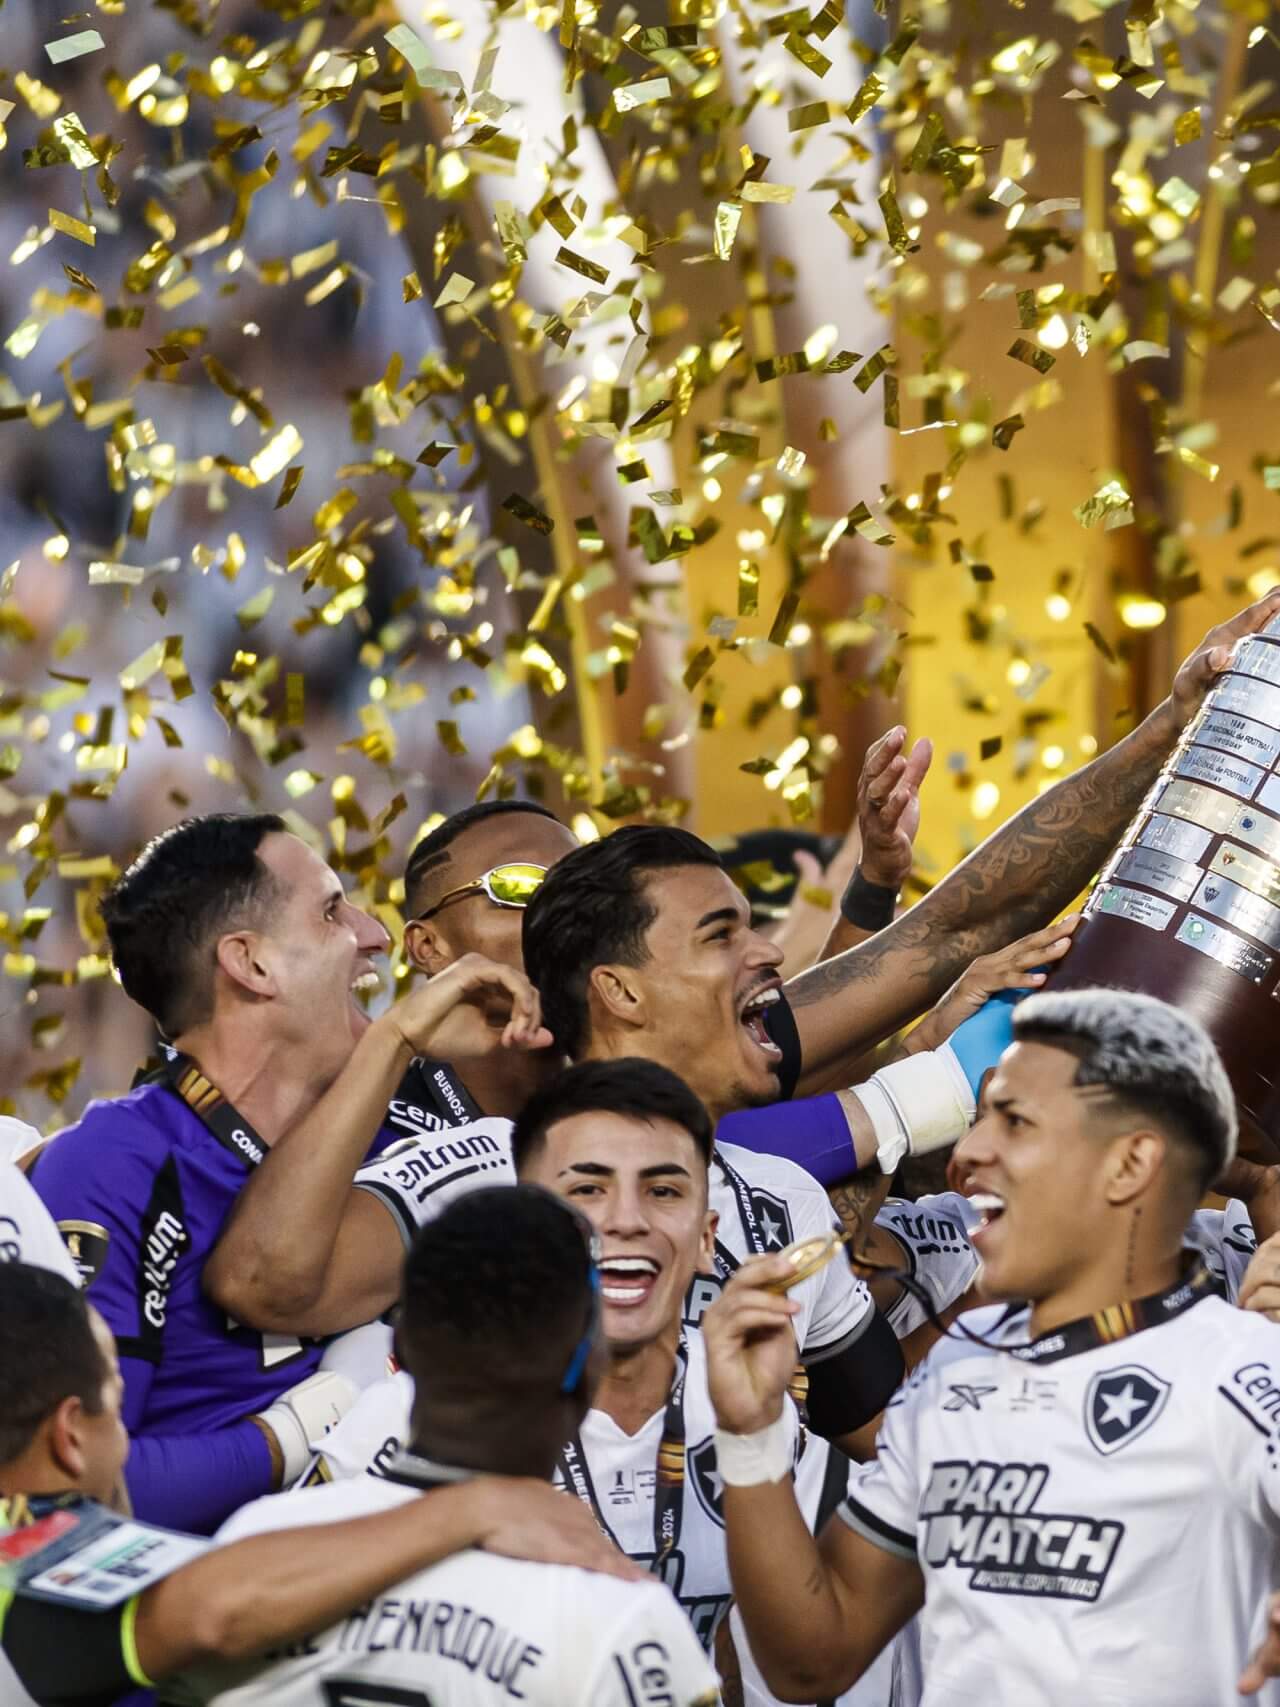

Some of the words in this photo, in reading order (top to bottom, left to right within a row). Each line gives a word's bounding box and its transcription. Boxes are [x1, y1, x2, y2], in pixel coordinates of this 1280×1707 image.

[433, 1069, 465, 1118] BUENOS
[383, 1135, 501, 1191] entrum
[921, 1460, 1050, 1519] PARI
[663, 1507, 674, 1540] 2024
[922, 1512, 1125, 1574] MATCH
